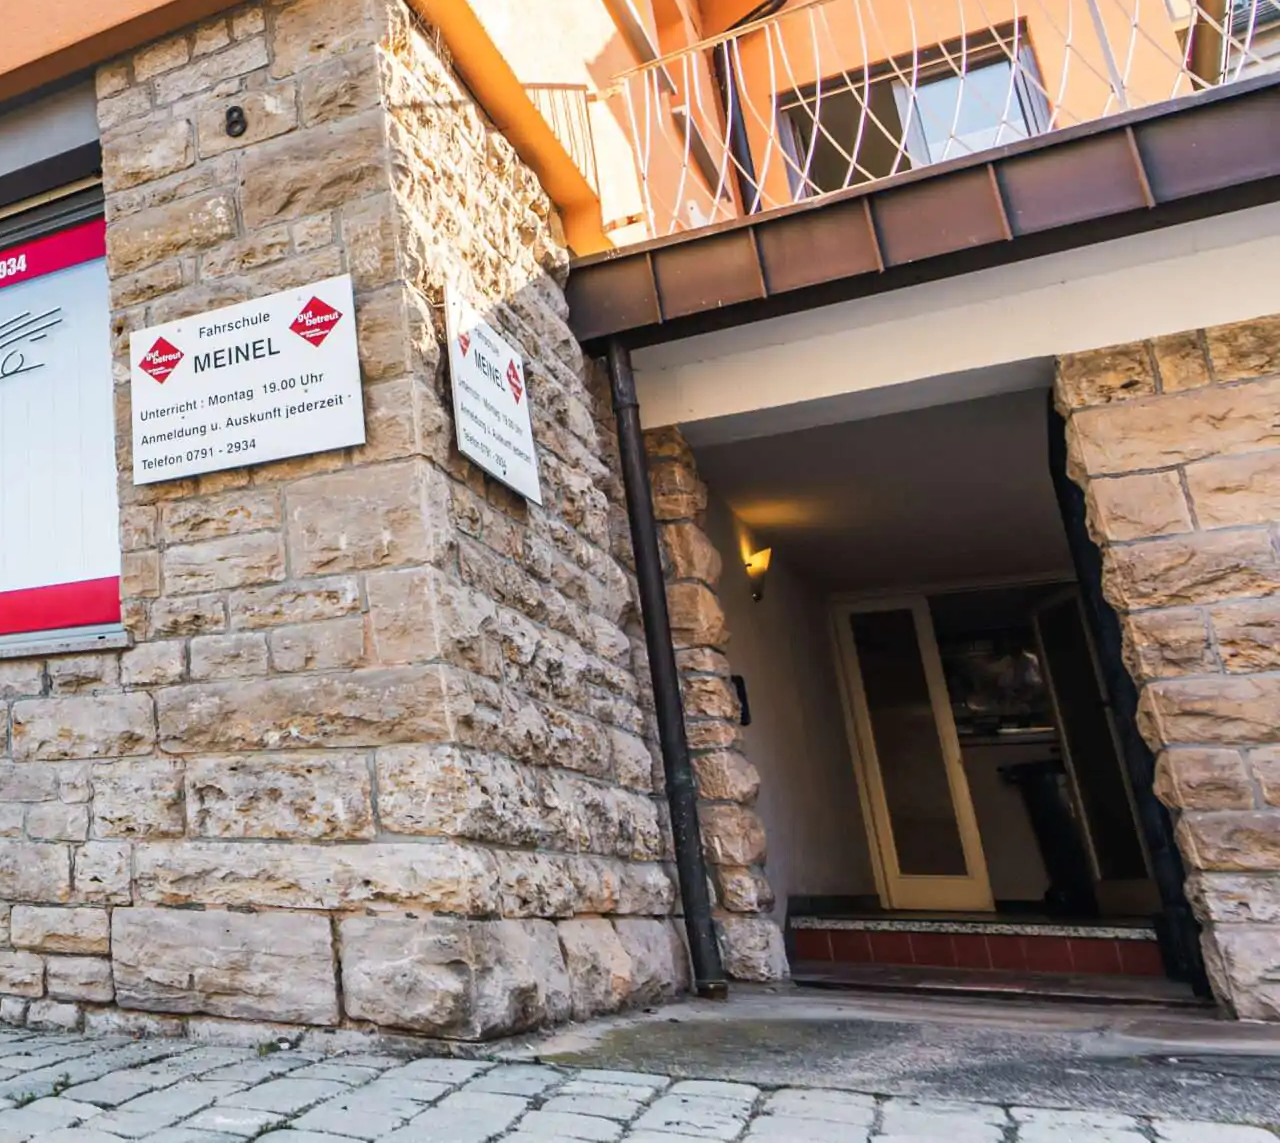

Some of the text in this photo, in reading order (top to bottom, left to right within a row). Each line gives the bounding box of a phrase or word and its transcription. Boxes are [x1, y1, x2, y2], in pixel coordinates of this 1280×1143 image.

[198, 312, 270, 338] Fahrschule
[193, 337, 280, 374] MEINEL
[474, 348, 505, 392] MEINEL
[140, 399, 197, 421] Unterricht
[208, 389, 254, 407] Montag
[263, 377, 296, 394] 19.00
[300, 372, 324, 386] Uhr
[141, 394, 343, 445] Anmeldung u. Auskunft jederzeit
[142, 454, 183, 470] Telefon
[186, 447, 213, 462] 0791
[226, 438, 256, 453] 2934
